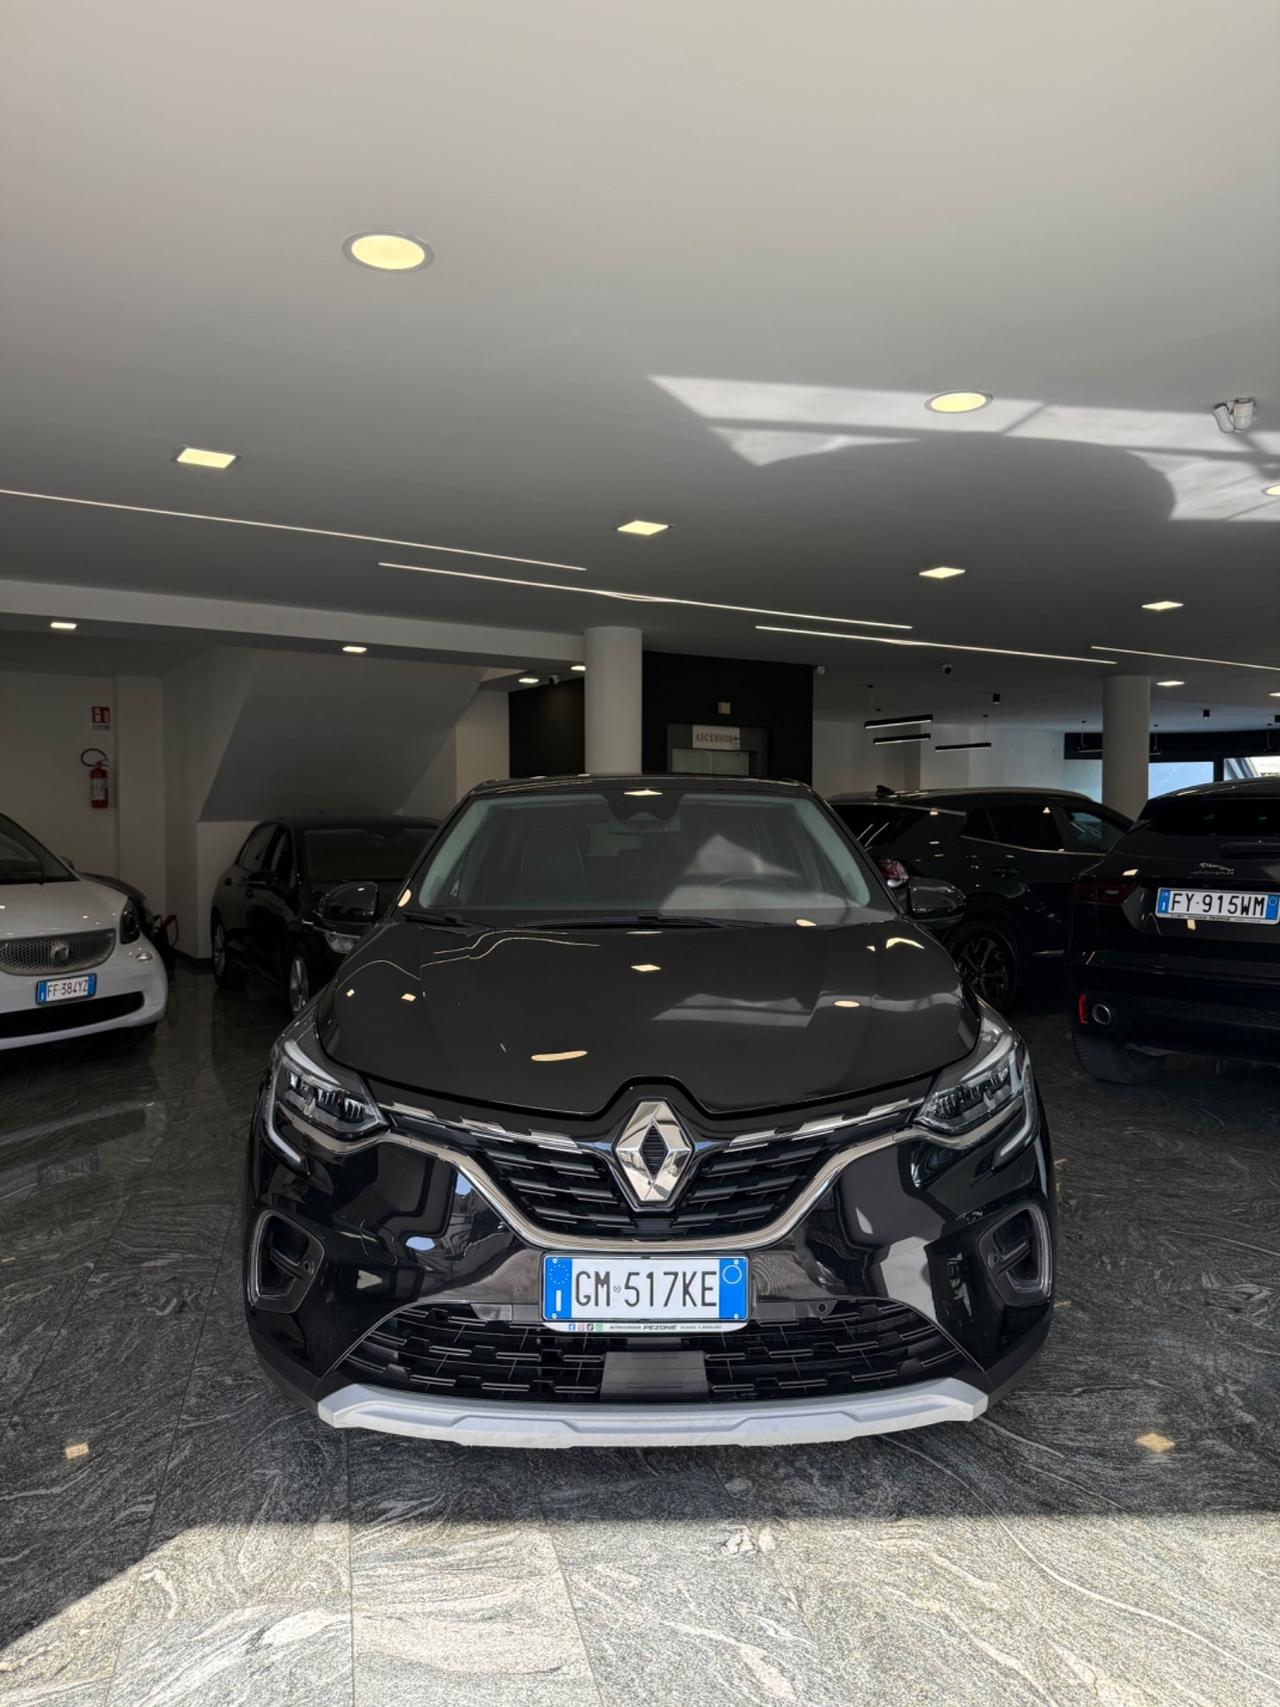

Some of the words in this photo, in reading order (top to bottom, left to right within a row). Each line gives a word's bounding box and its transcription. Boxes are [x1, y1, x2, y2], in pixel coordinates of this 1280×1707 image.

[1171, 893, 1195, 912] FY
[1202, 894, 1265, 916] 915WM
[47, 984, 59, 998] FF
[61, 979, 88, 996] 384YZ
[575, 1271, 611, 1307] GM
[624, 1271, 717, 1307] 517KE
